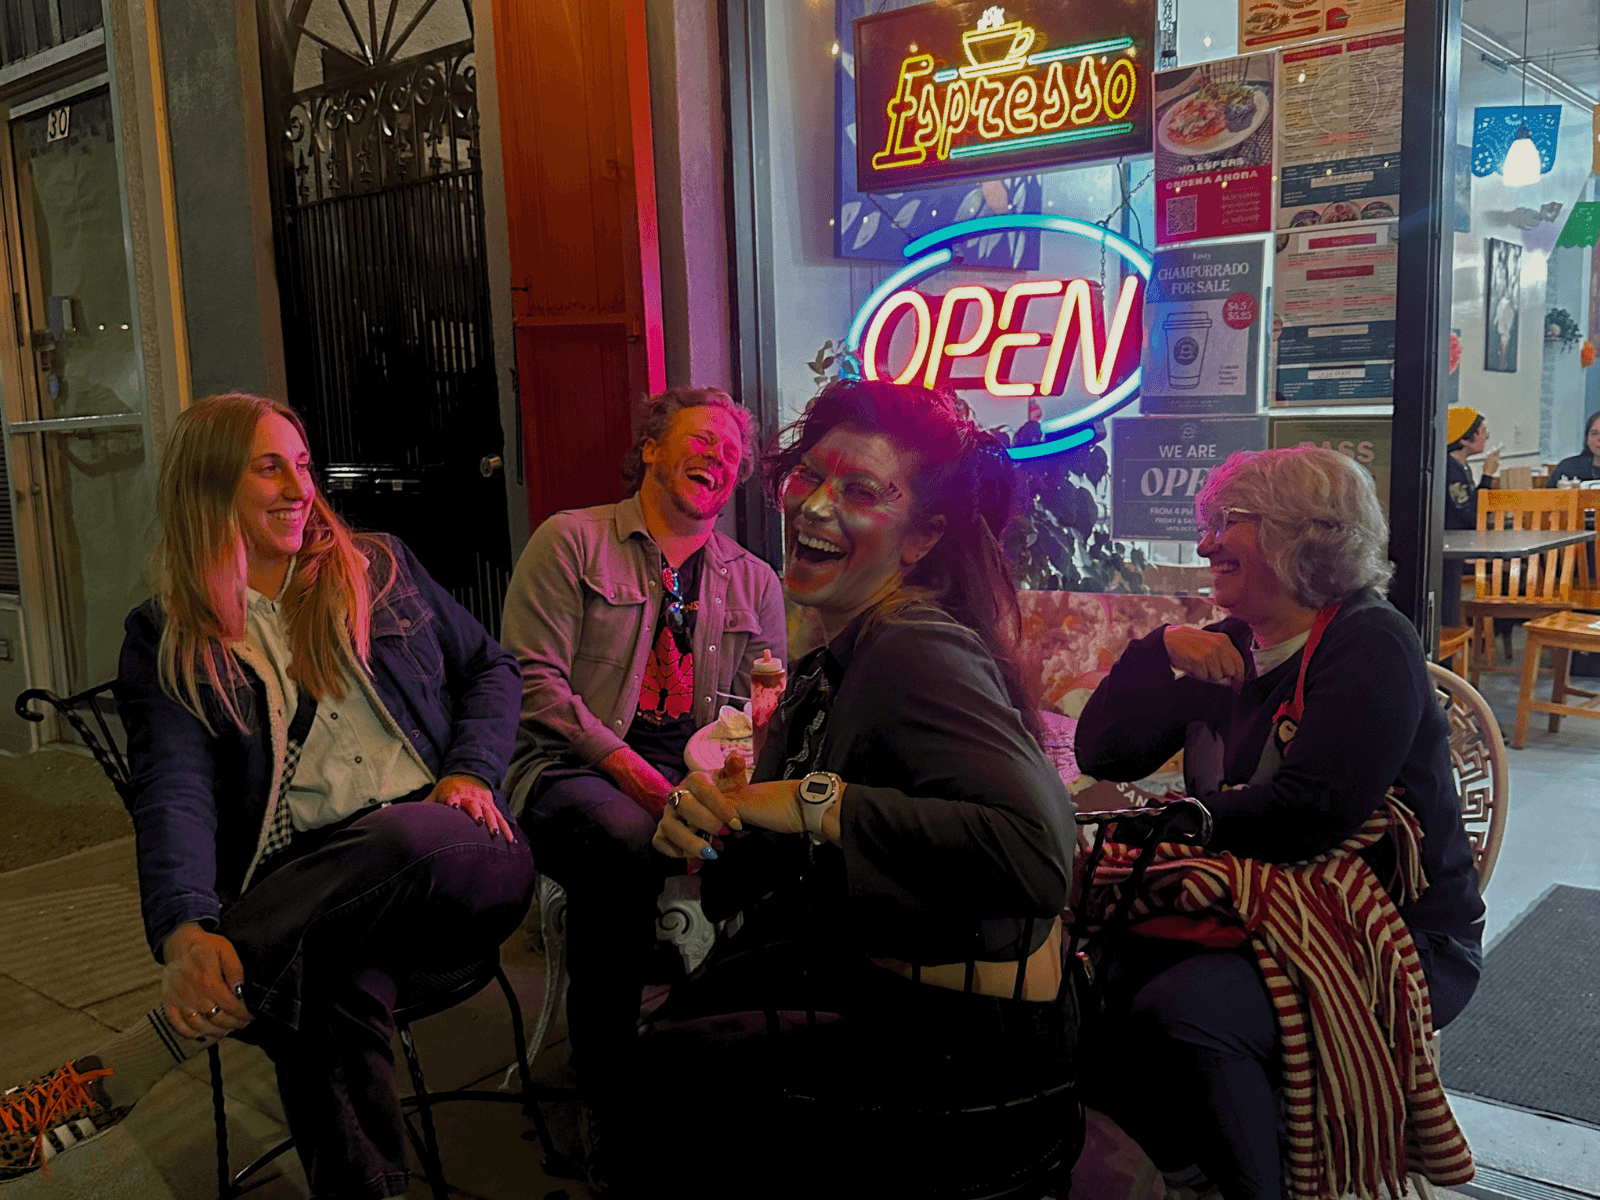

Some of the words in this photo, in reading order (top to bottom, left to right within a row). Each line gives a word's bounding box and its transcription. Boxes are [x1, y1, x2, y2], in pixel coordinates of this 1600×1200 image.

[871, 53, 1137, 170] Espresso
[49, 109, 67, 139] 30
[1157, 262, 1250, 281] CHAMPURRADO
[1171, 281, 1196, 295] FOR
[1196, 279, 1231, 294] SALE
[863, 274, 1139, 397] OPEN
[1158, 444, 1183, 458] WE
[1186, 444, 1217, 458] ARE
[1140, 467, 1212, 497] OPE
[1150, 507, 1173, 515] FROM
[1174, 507, 1180, 515] 4
[1180, 507, 1194, 515] PM
